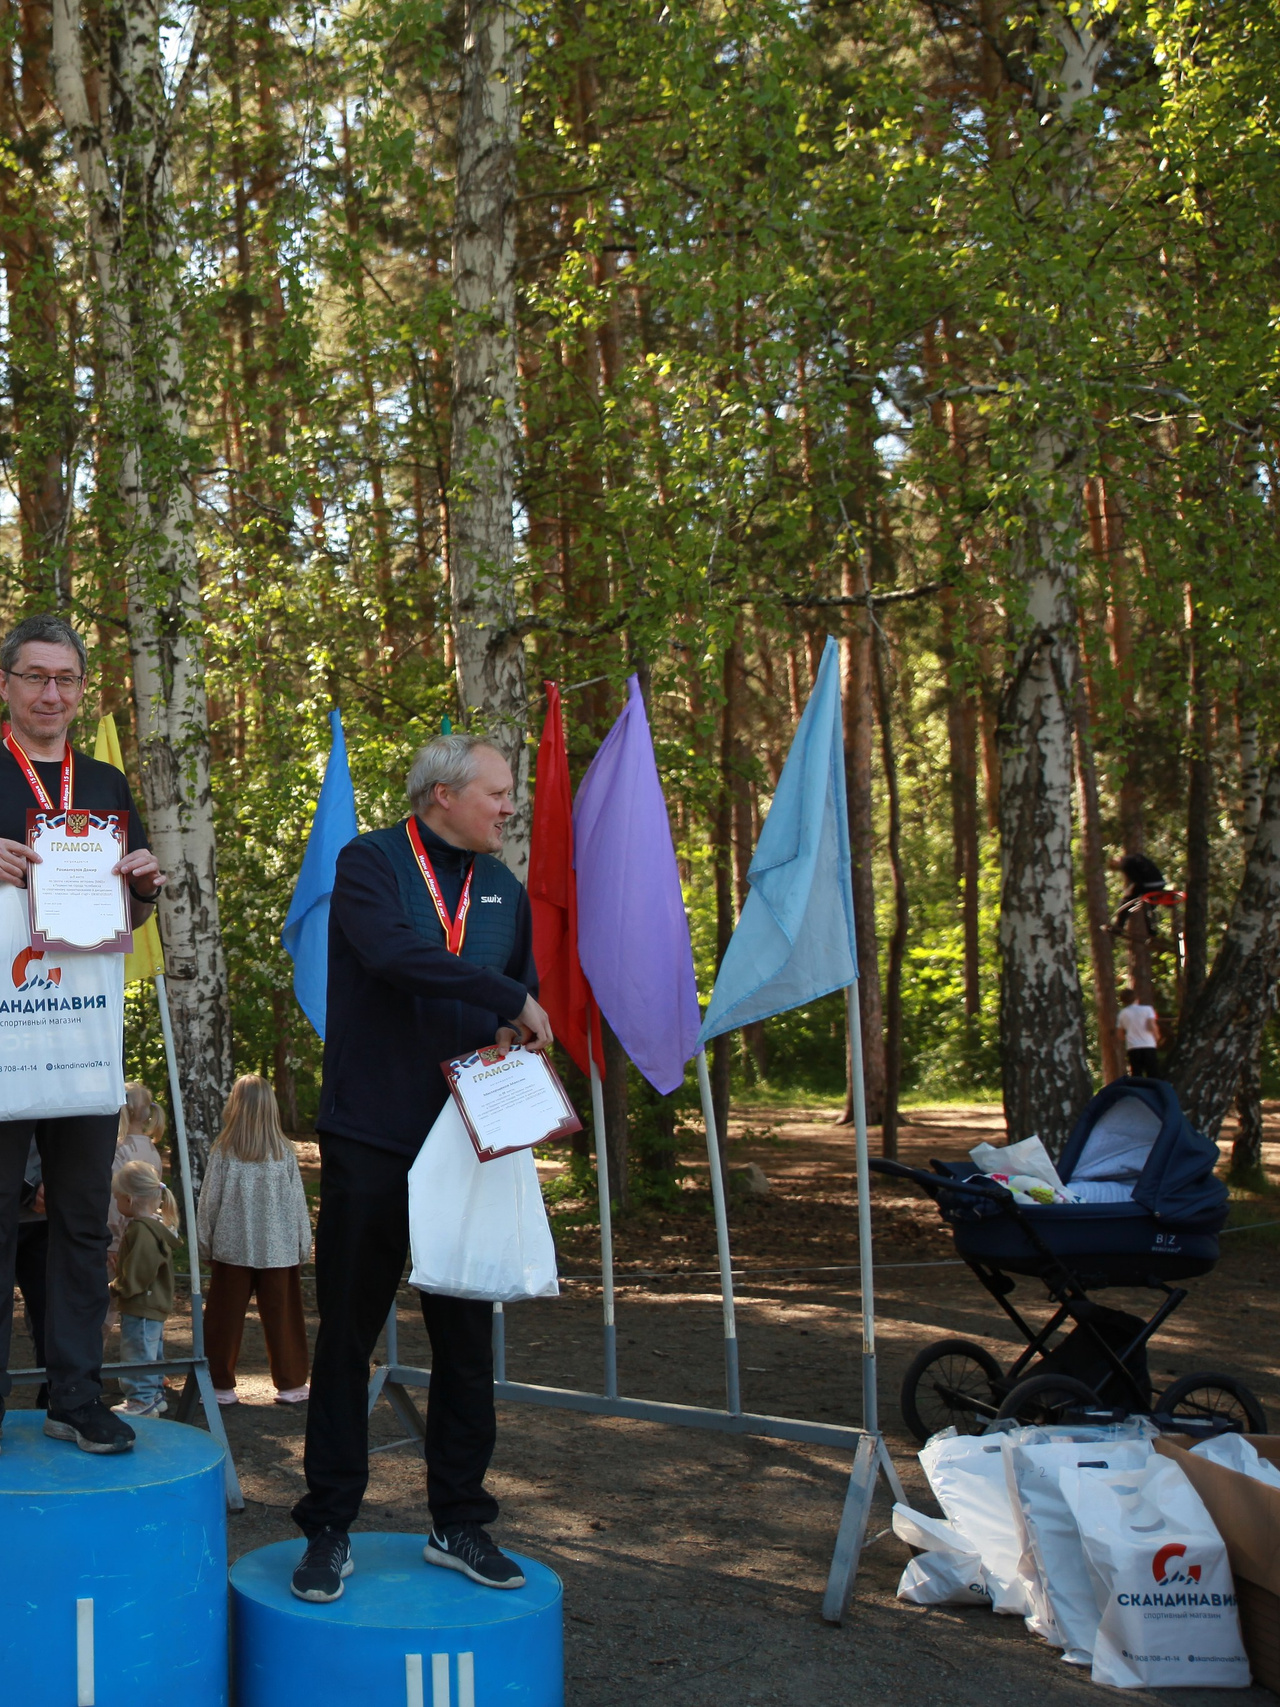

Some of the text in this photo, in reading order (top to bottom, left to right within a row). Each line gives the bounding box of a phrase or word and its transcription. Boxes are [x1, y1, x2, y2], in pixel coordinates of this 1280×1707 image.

[26, 768, 34, 777] лет
[50, 842, 103, 852] ГРАМОТА
[419, 855, 427, 869] Иван
[429, 879, 438, 897] Марья
[481, 895, 502, 904] swix
[0, 1017, 82, 1028] спортивный магазин
[3, 1065, 38, 1073] 708-41-14
[53, 1061, 111, 1070] skandinavia74.ru
[472, 1059, 524, 1083] ГРАМОТА
[1143, 1611, 1188, 1620] спортивный
